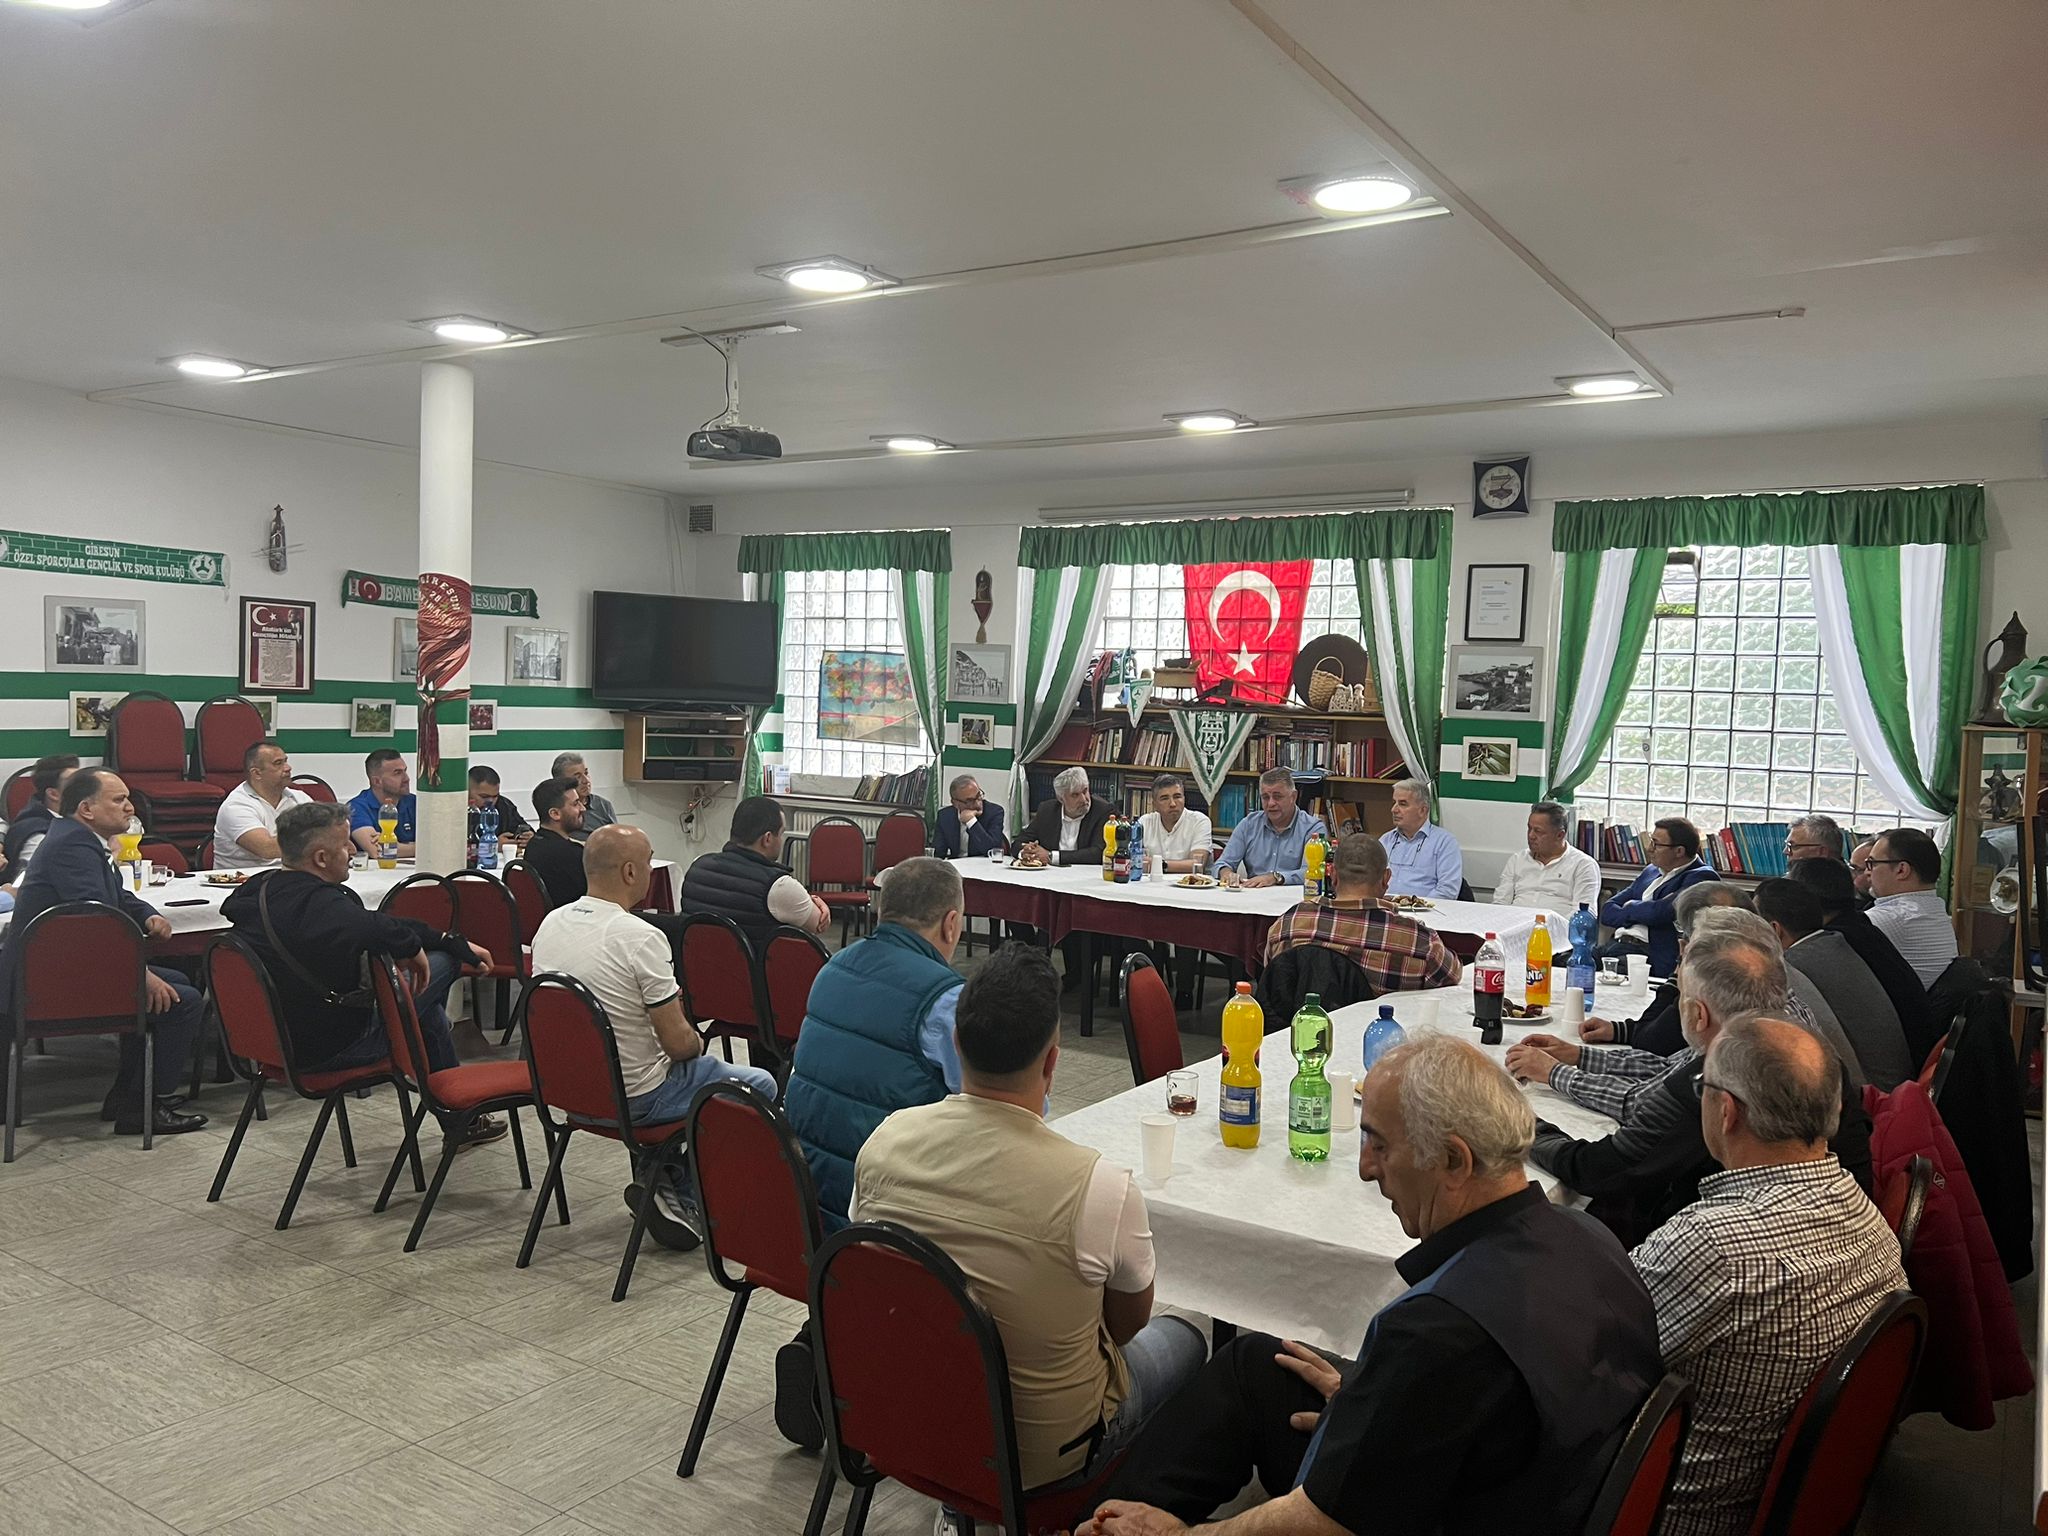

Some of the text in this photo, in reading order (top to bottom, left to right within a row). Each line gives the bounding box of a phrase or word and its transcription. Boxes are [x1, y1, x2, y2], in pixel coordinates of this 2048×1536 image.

[13, 549, 185, 578] ÖZEL SPORCULAR GENÇLİK VE SPOR KULÜBÜ
[385, 584, 419, 603] BAMB
